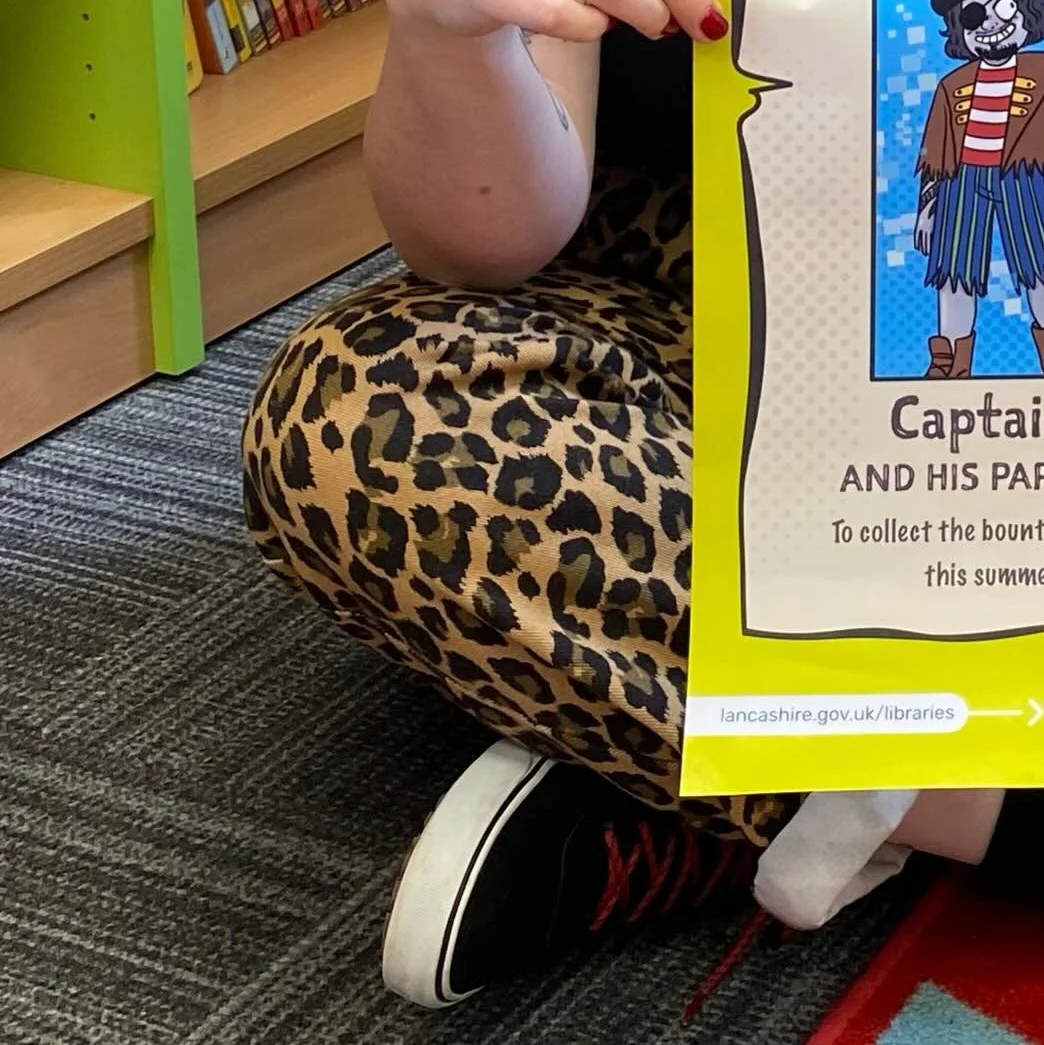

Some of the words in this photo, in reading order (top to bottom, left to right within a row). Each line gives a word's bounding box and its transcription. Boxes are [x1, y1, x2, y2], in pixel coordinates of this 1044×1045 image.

[840, 464, 915, 492] AND
[927, 462, 979, 491] HIS
[832, 519, 853, 543] To
[860, 517, 932, 544] collect
[939, 517, 975, 542] the
[925, 562, 967, 587] this
[720, 704, 955, 724] lancashire.gov.uk/libraries
